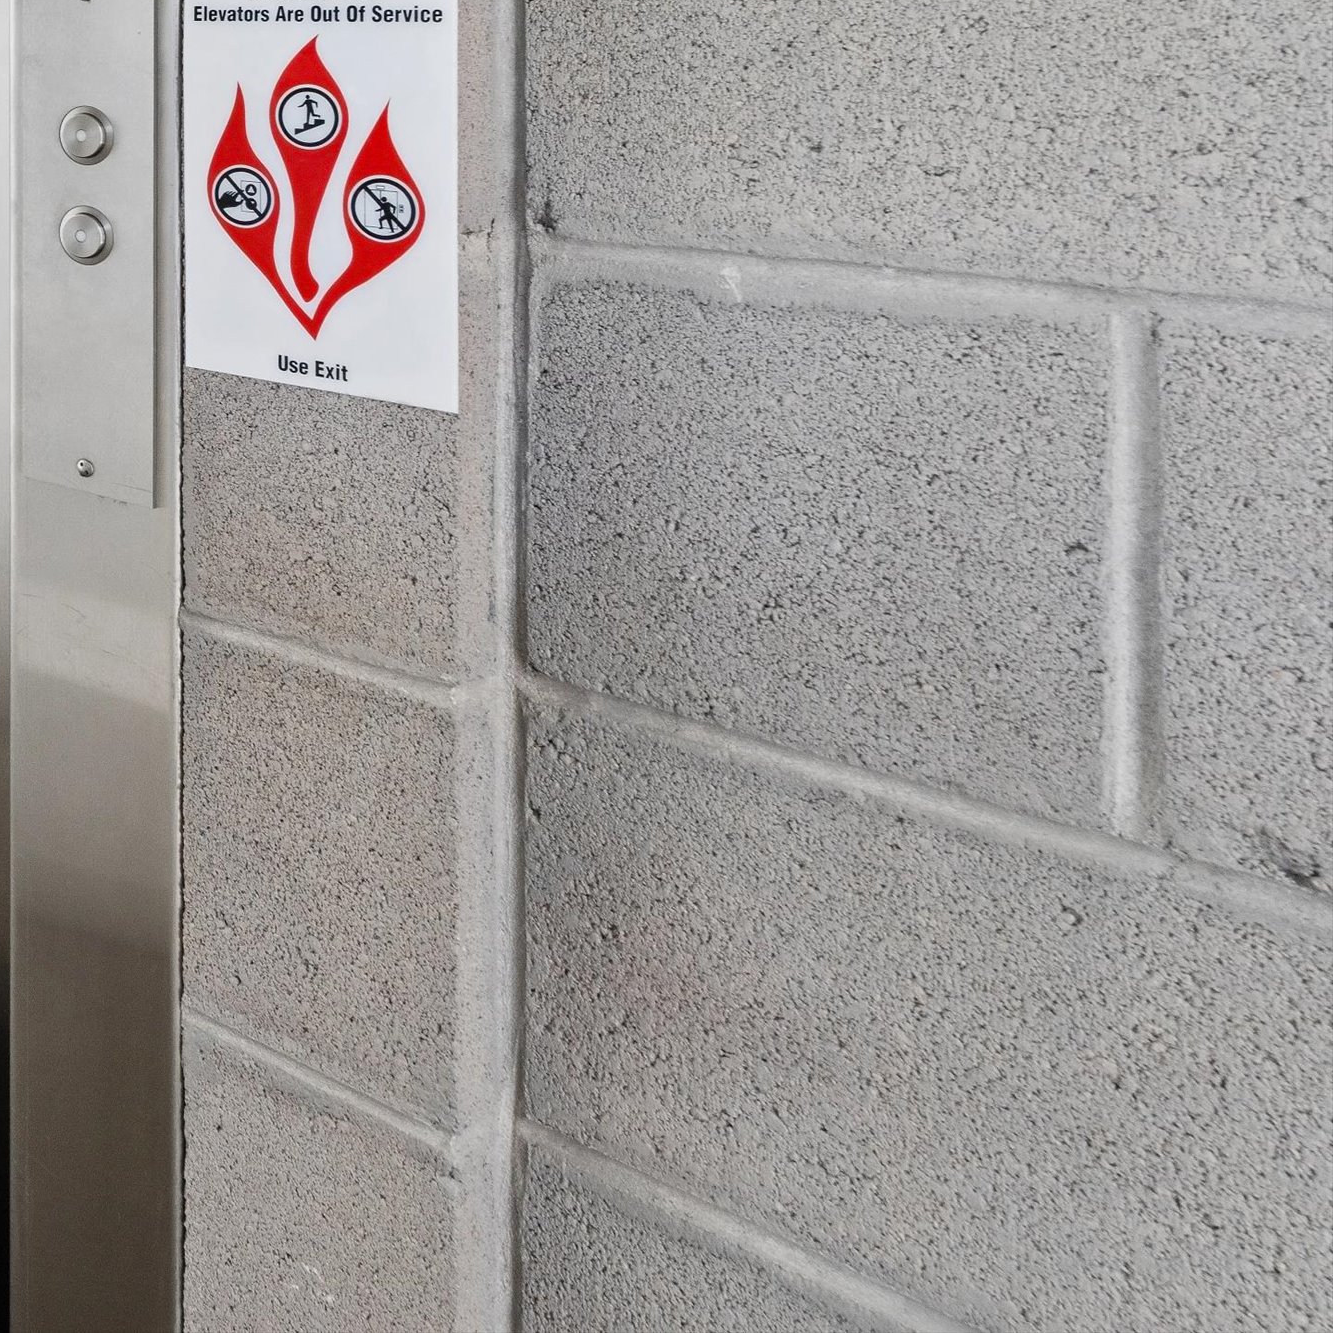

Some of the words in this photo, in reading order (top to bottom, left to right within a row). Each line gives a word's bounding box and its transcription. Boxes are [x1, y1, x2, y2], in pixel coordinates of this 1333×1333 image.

[193, 6, 270, 22] Elevators
[276, 6, 304, 22] Are
[311, 6, 340, 22] Out
[346, 5, 366, 22] Of
[372, 5, 443, 23] Service
[278, 354, 309, 375] Use
[315, 360, 348, 382] Exit
